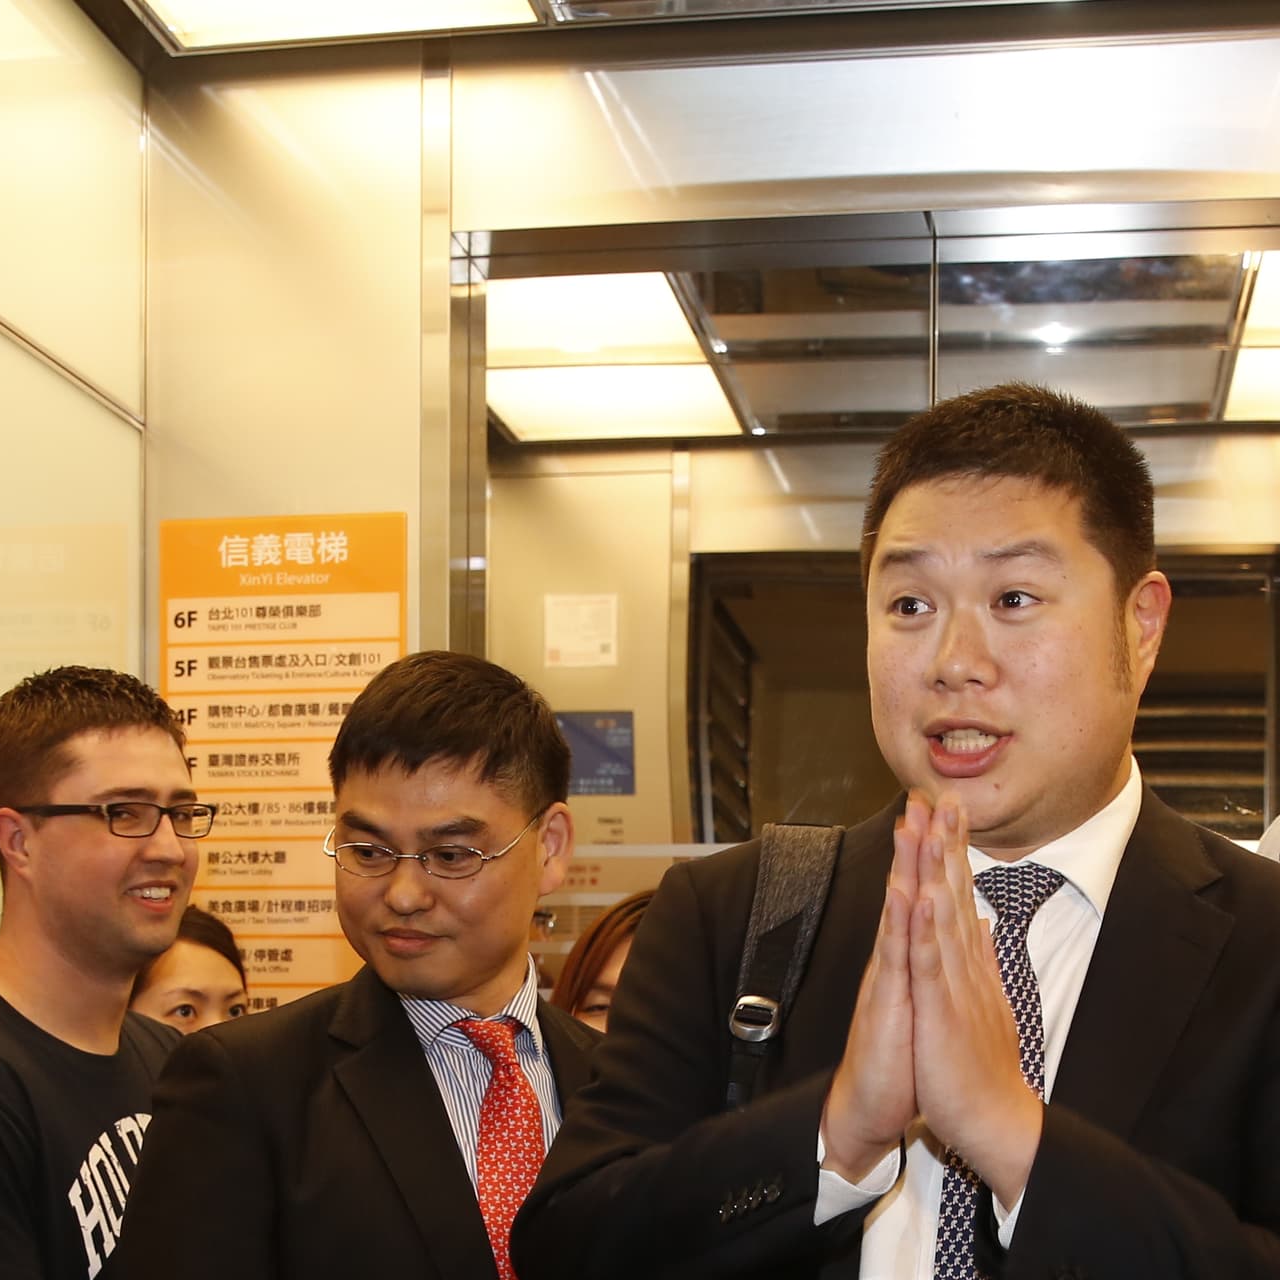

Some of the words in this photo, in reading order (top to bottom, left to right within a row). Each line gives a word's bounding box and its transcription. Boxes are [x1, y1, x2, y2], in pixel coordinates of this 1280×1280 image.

[218, 531, 349, 568] 信義電梯
[276, 572, 331, 586] Elevator
[174, 610, 198, 628] 6F
[174, 659, 198, 677] 5F
[175, 708, 198, 725] 4F
